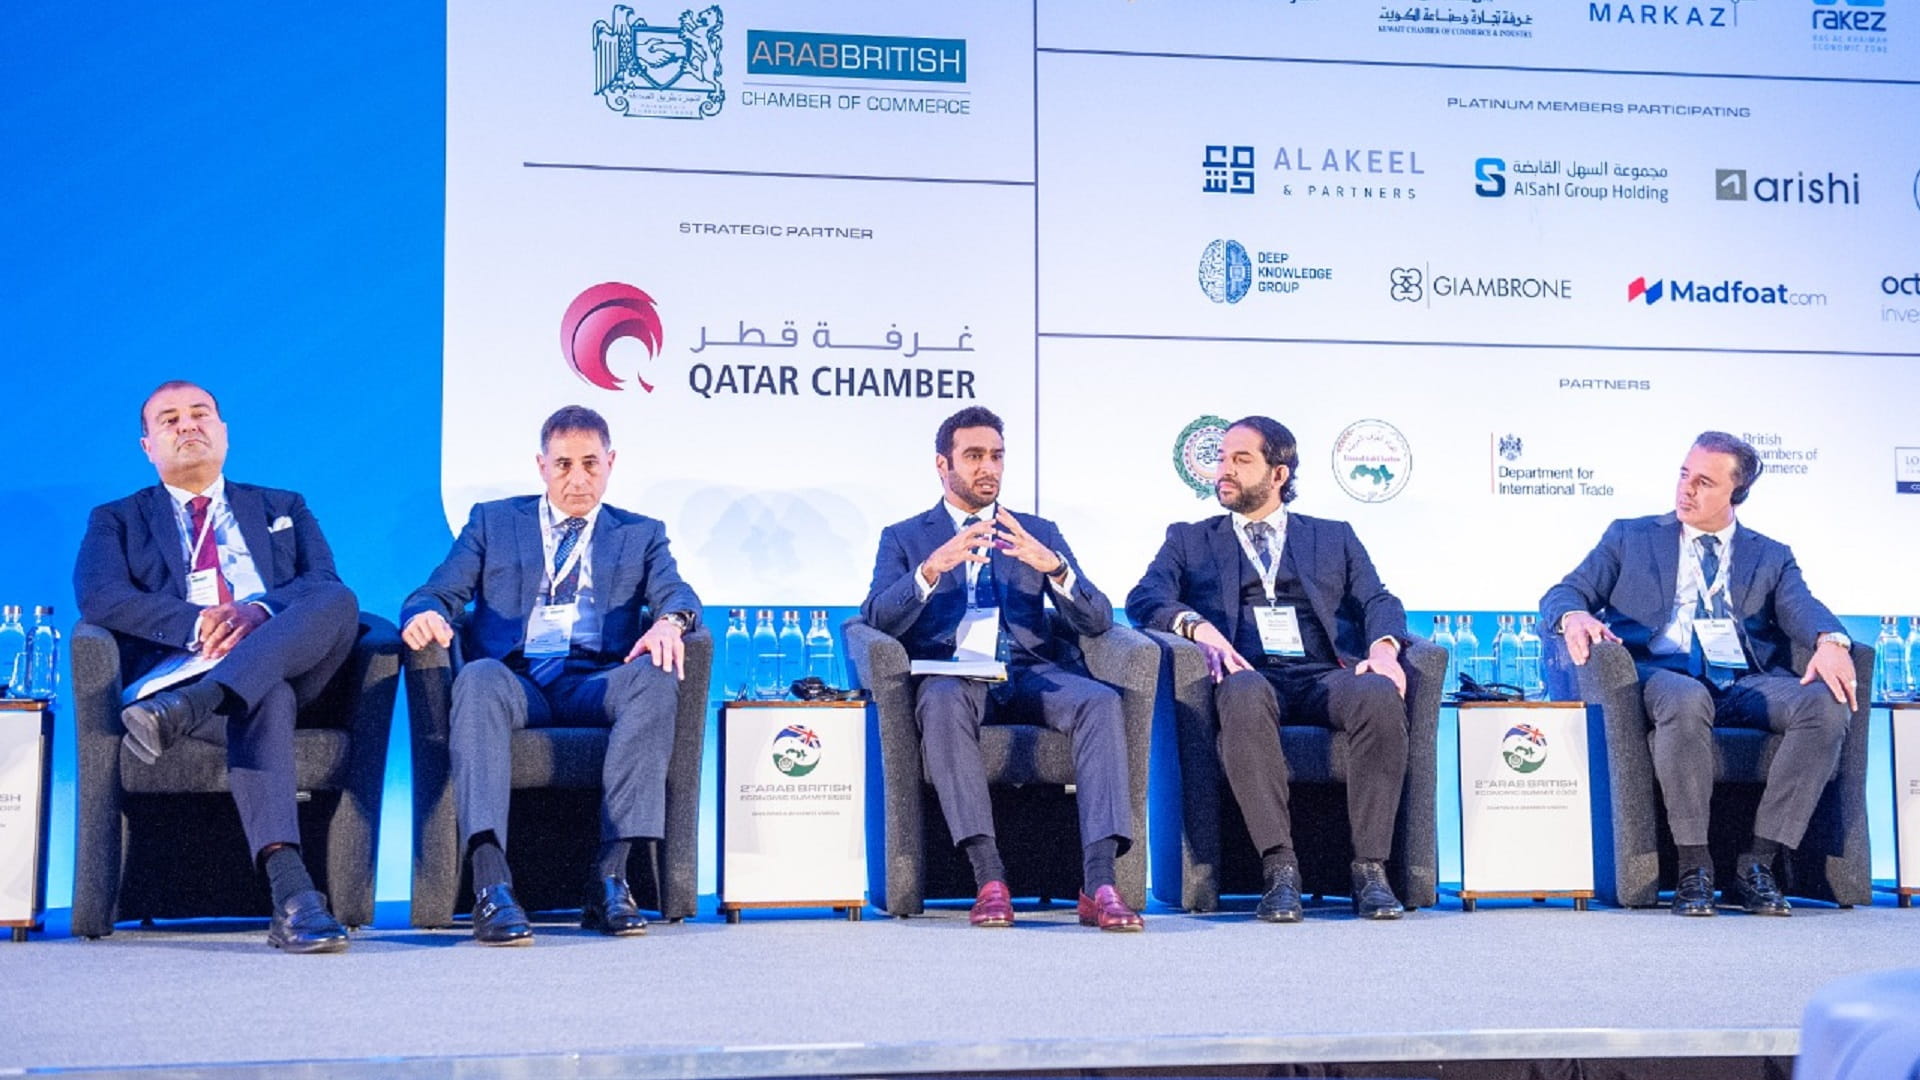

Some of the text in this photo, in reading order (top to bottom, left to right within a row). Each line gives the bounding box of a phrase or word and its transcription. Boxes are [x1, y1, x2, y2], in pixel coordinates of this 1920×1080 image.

[1589, 2, 1726, 27] MARKAZ
[1812, 9, 1887, 32] rakez
[742, 91, 970, 115] CHAMBER OF COMMERCE
[1447, 97, 1751, 118] PLATINUM MEMBERS PARTICIPATING
[1273, 146, 1312, 171] AL
[1321, 148, 1425, 175] AKEEL
[1513, 160, 1668, 180] مجموعة السهل القابضة
[1283, 184, 1416, 200] & PARTNERS
[1513, 181, 1669, 204] AlSahl Group Holding
[1753, 171, 1860, 205] arishi
[679, 222, 873, 240] STRATEGIC PARTNER
[1257, 251, 1290, 264] DEEP
[1257, 266, 1333, 280] KNOWLEDGE
[1257, 281, 1300, 294] GROUP
[1433, 275, 1572, 299] GIAMBRONE
[689, 320, 975, 358] غرفة قطر
[688, 362, 976, 399] QATAR CHAMBER
[1559, 378, 1651, 391] PARTNERS
[1498, 465, 1594, 481] Department for
[1499, 482, 1615, 496] International Trade
